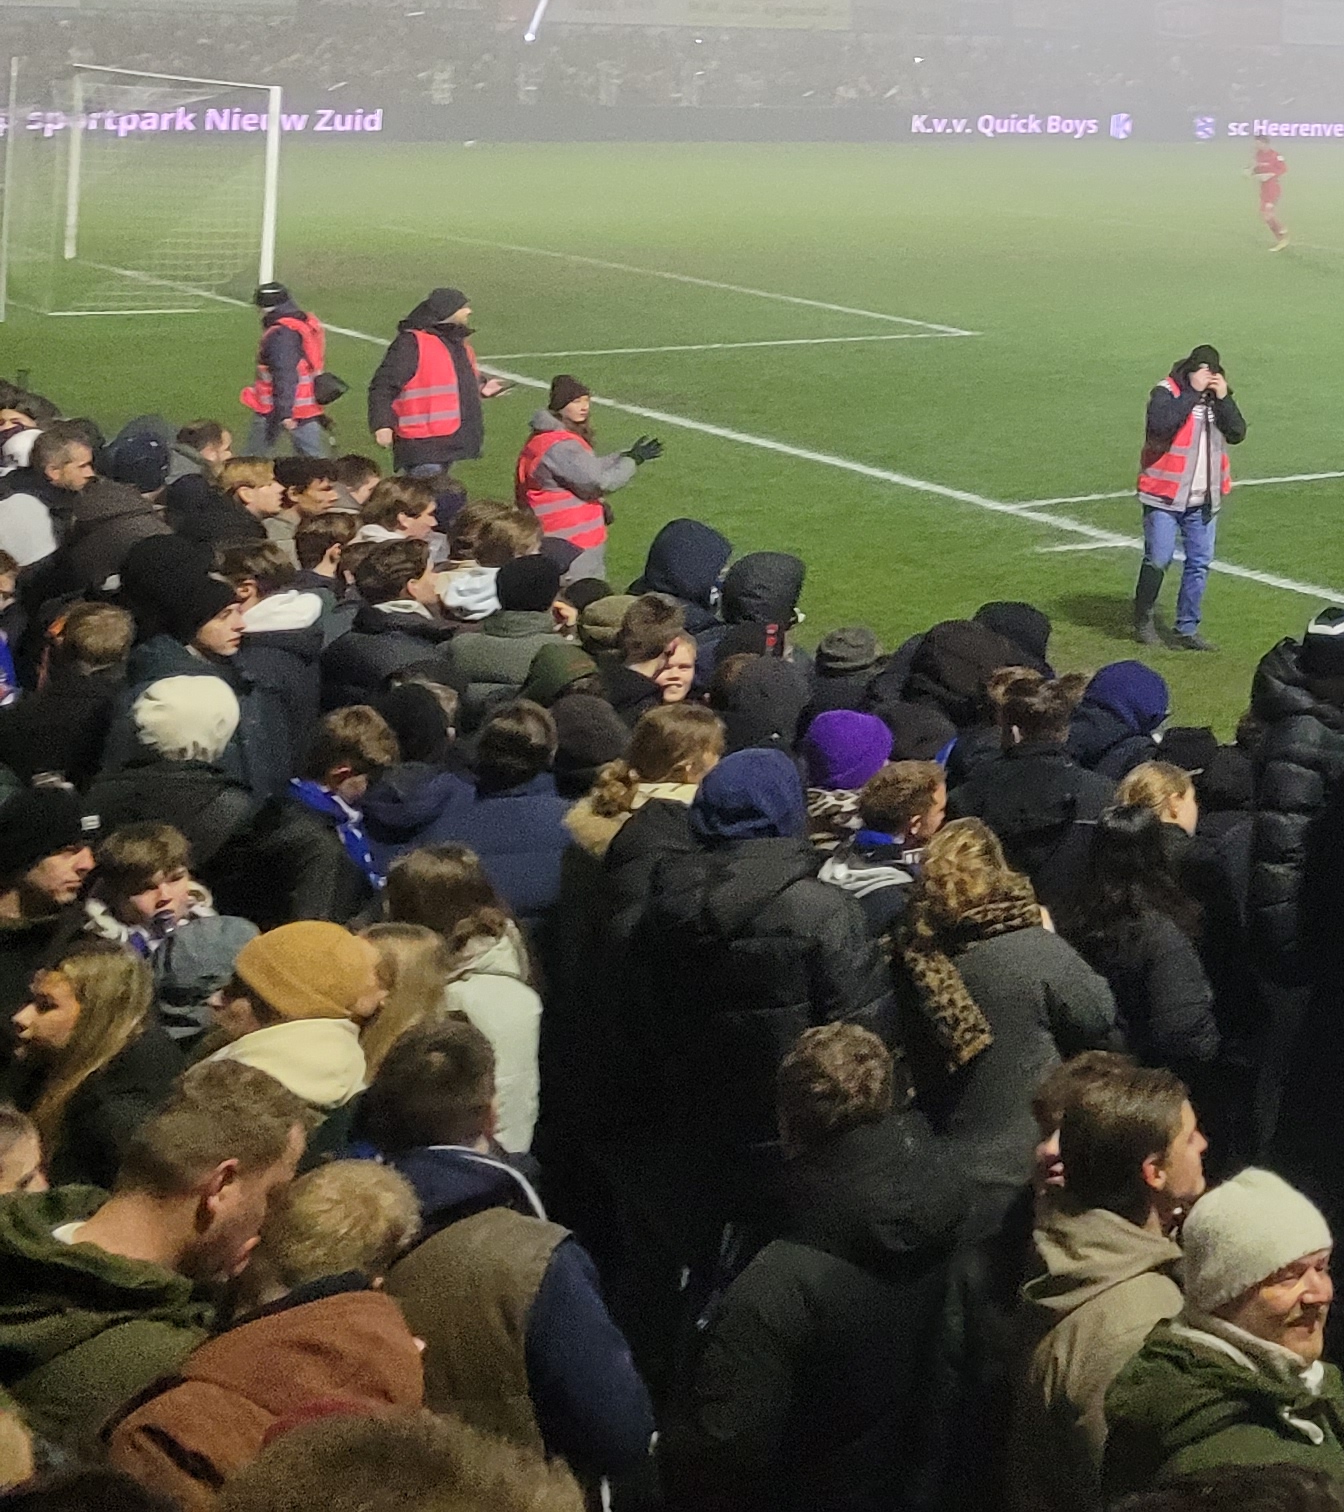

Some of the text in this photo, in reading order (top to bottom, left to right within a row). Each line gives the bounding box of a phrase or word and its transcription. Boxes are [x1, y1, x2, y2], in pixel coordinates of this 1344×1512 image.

[26, 107, 197, 136] sprtpark
[313, 109, 383, 131] Zuid
[911, 113, 1099, 138] K.v.v. Quick Boys
[1227, 121, 1249, 136] sc
